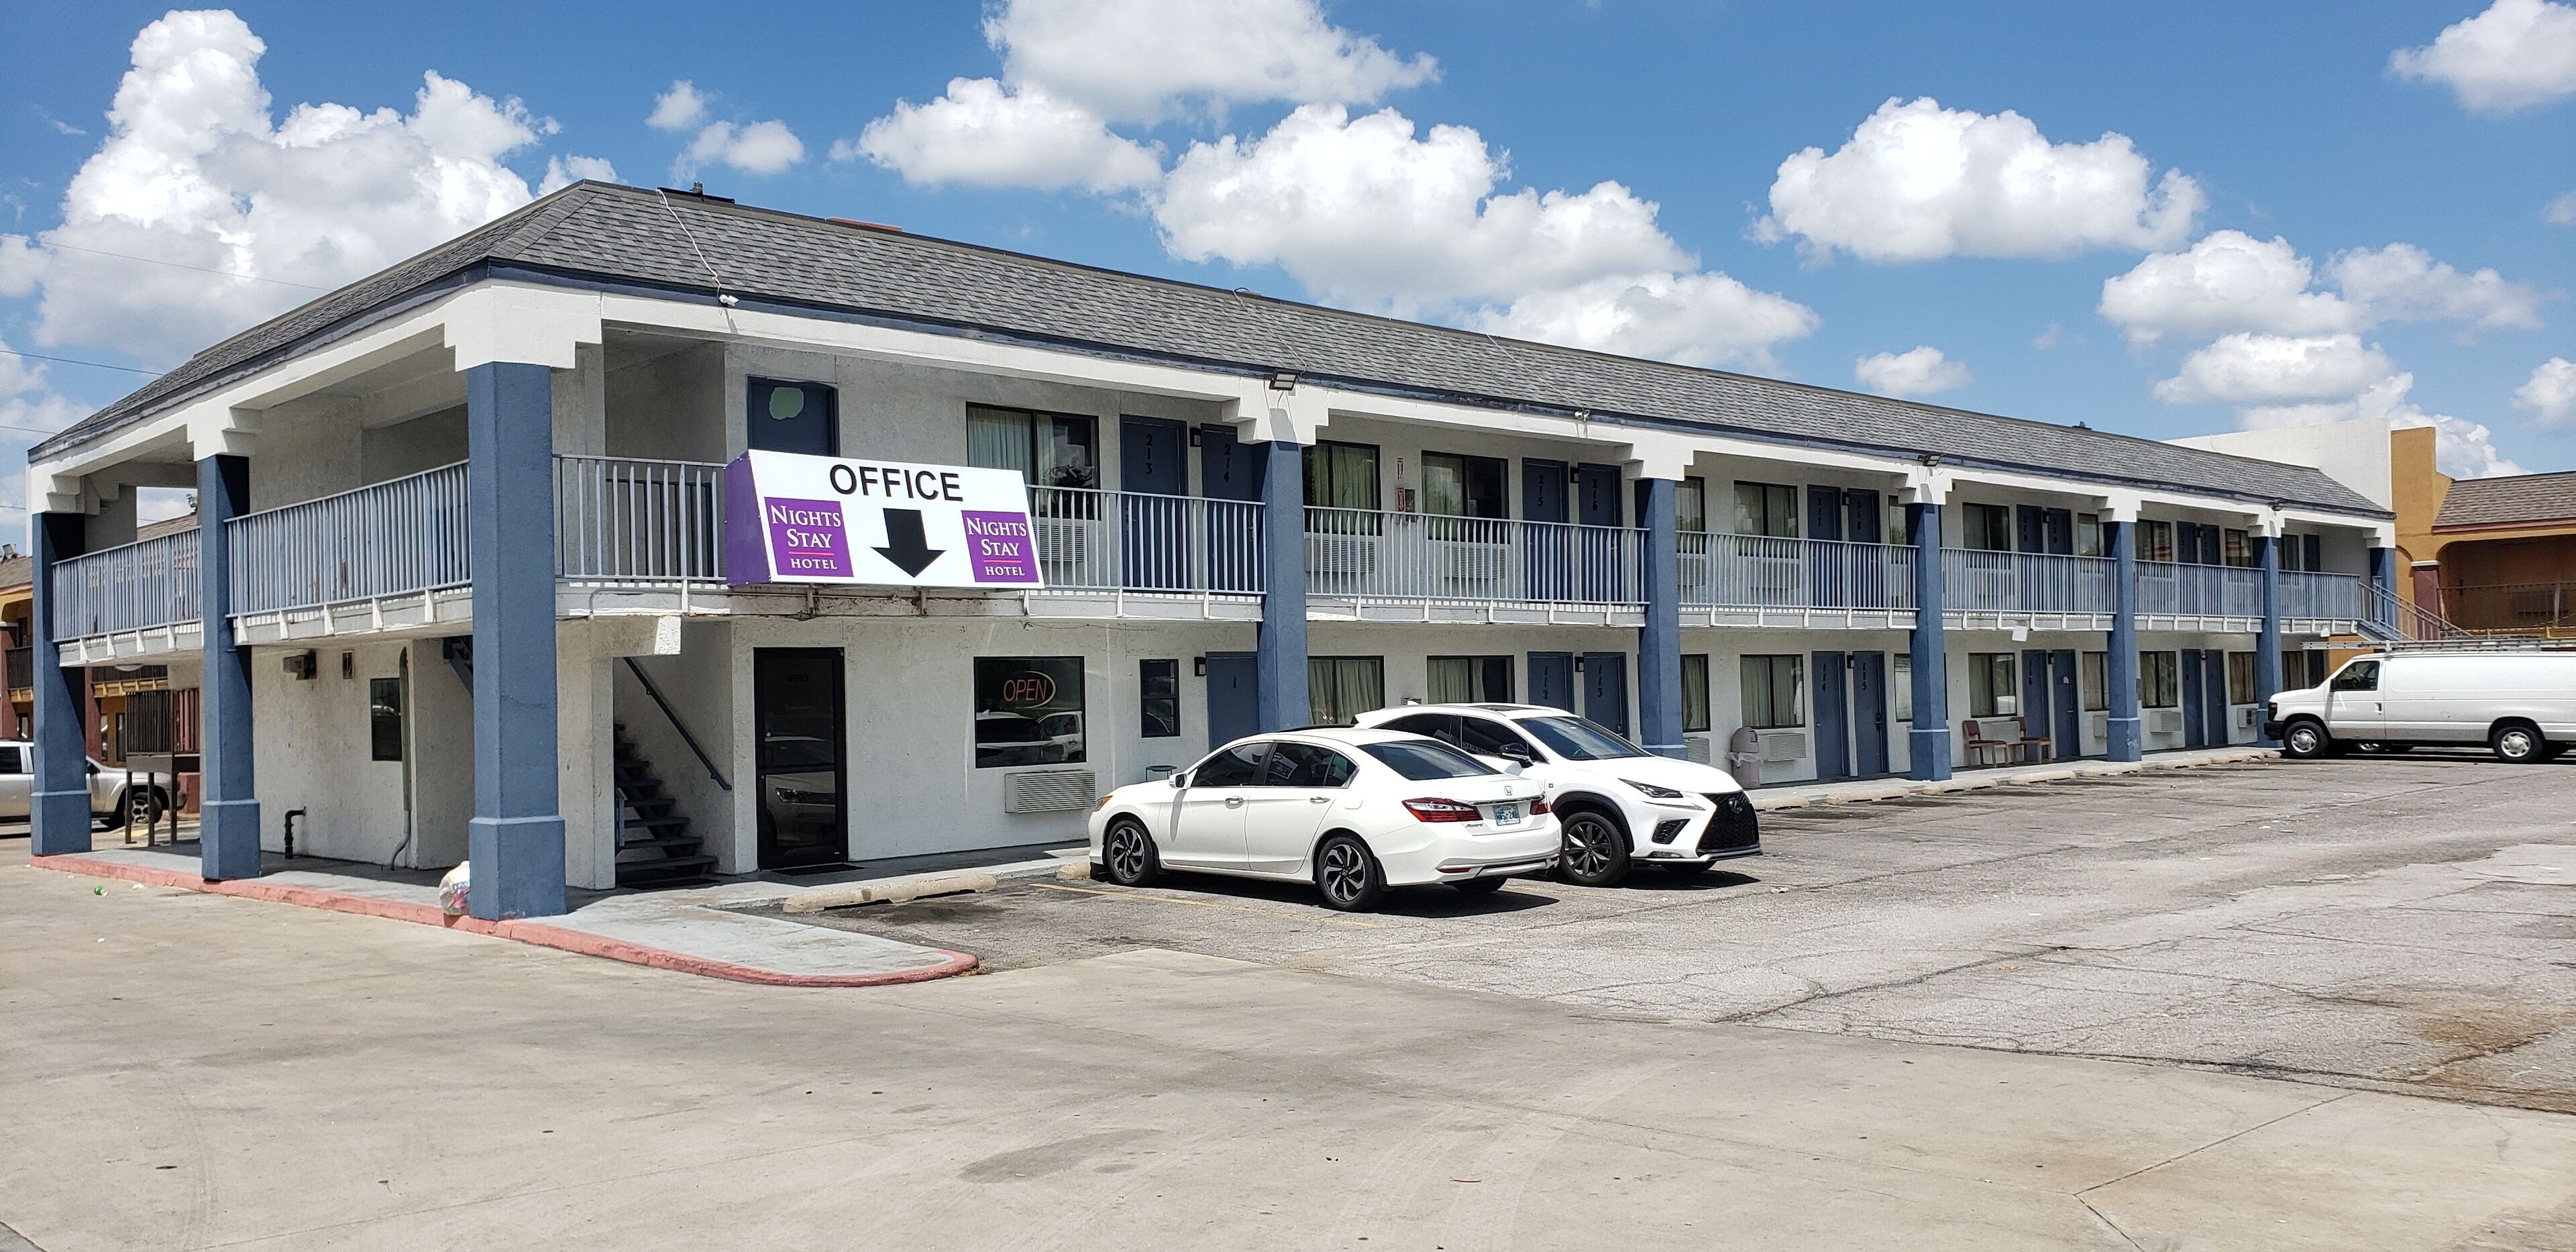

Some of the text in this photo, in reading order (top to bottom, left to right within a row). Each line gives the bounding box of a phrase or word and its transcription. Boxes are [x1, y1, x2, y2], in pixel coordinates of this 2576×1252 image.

[1144, 433, 1153, 474] 213
[1223, 444, 1231, 483] 214
[830, 464, 963, 502] OFFICE
[771, 505, 841, 527] NIGHTS
[967, 517, 1027, 537] NIGHTS
[787, 528, 833, 548] STAY
[981, 539, 1020, 556] STAY
[790, 558, 837, 570] HOTEL
[985, 566, 1025, 576] HOTEL
[1004, 678, 1047, 701] OPEN
